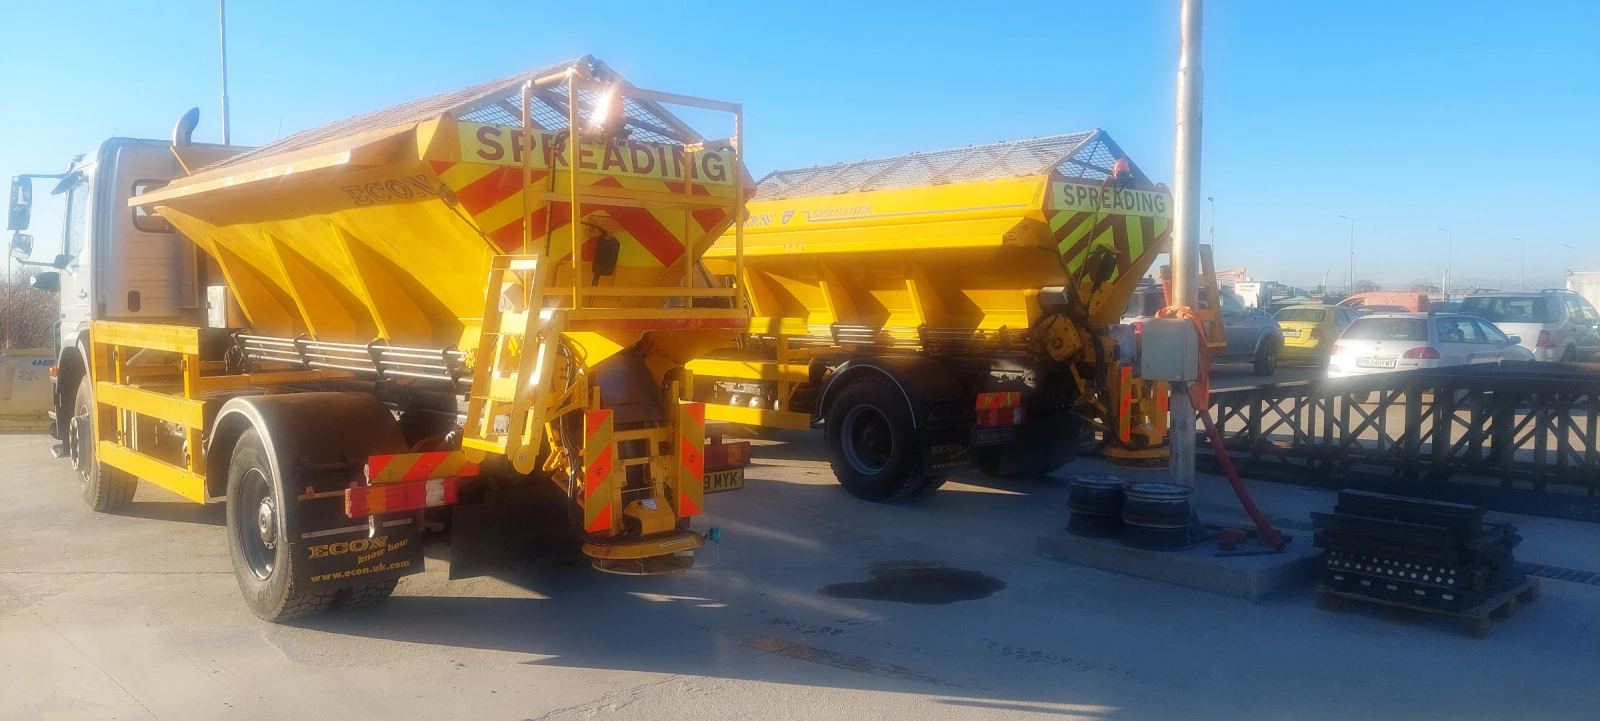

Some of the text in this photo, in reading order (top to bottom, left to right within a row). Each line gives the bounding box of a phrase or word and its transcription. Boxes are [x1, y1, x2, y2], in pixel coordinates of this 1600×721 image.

[475, 125, 727, 182] SPREADING
[342, 175, 437, 206] ECON
[1063, 184, 1166, 213] SPREADING
[714, 471, 738, 488] MYK
[308, 535, 388, 559] ECON
[357, 537, 409, 565] know how
[310, 558, 410, 583] www.econ.uk.com
